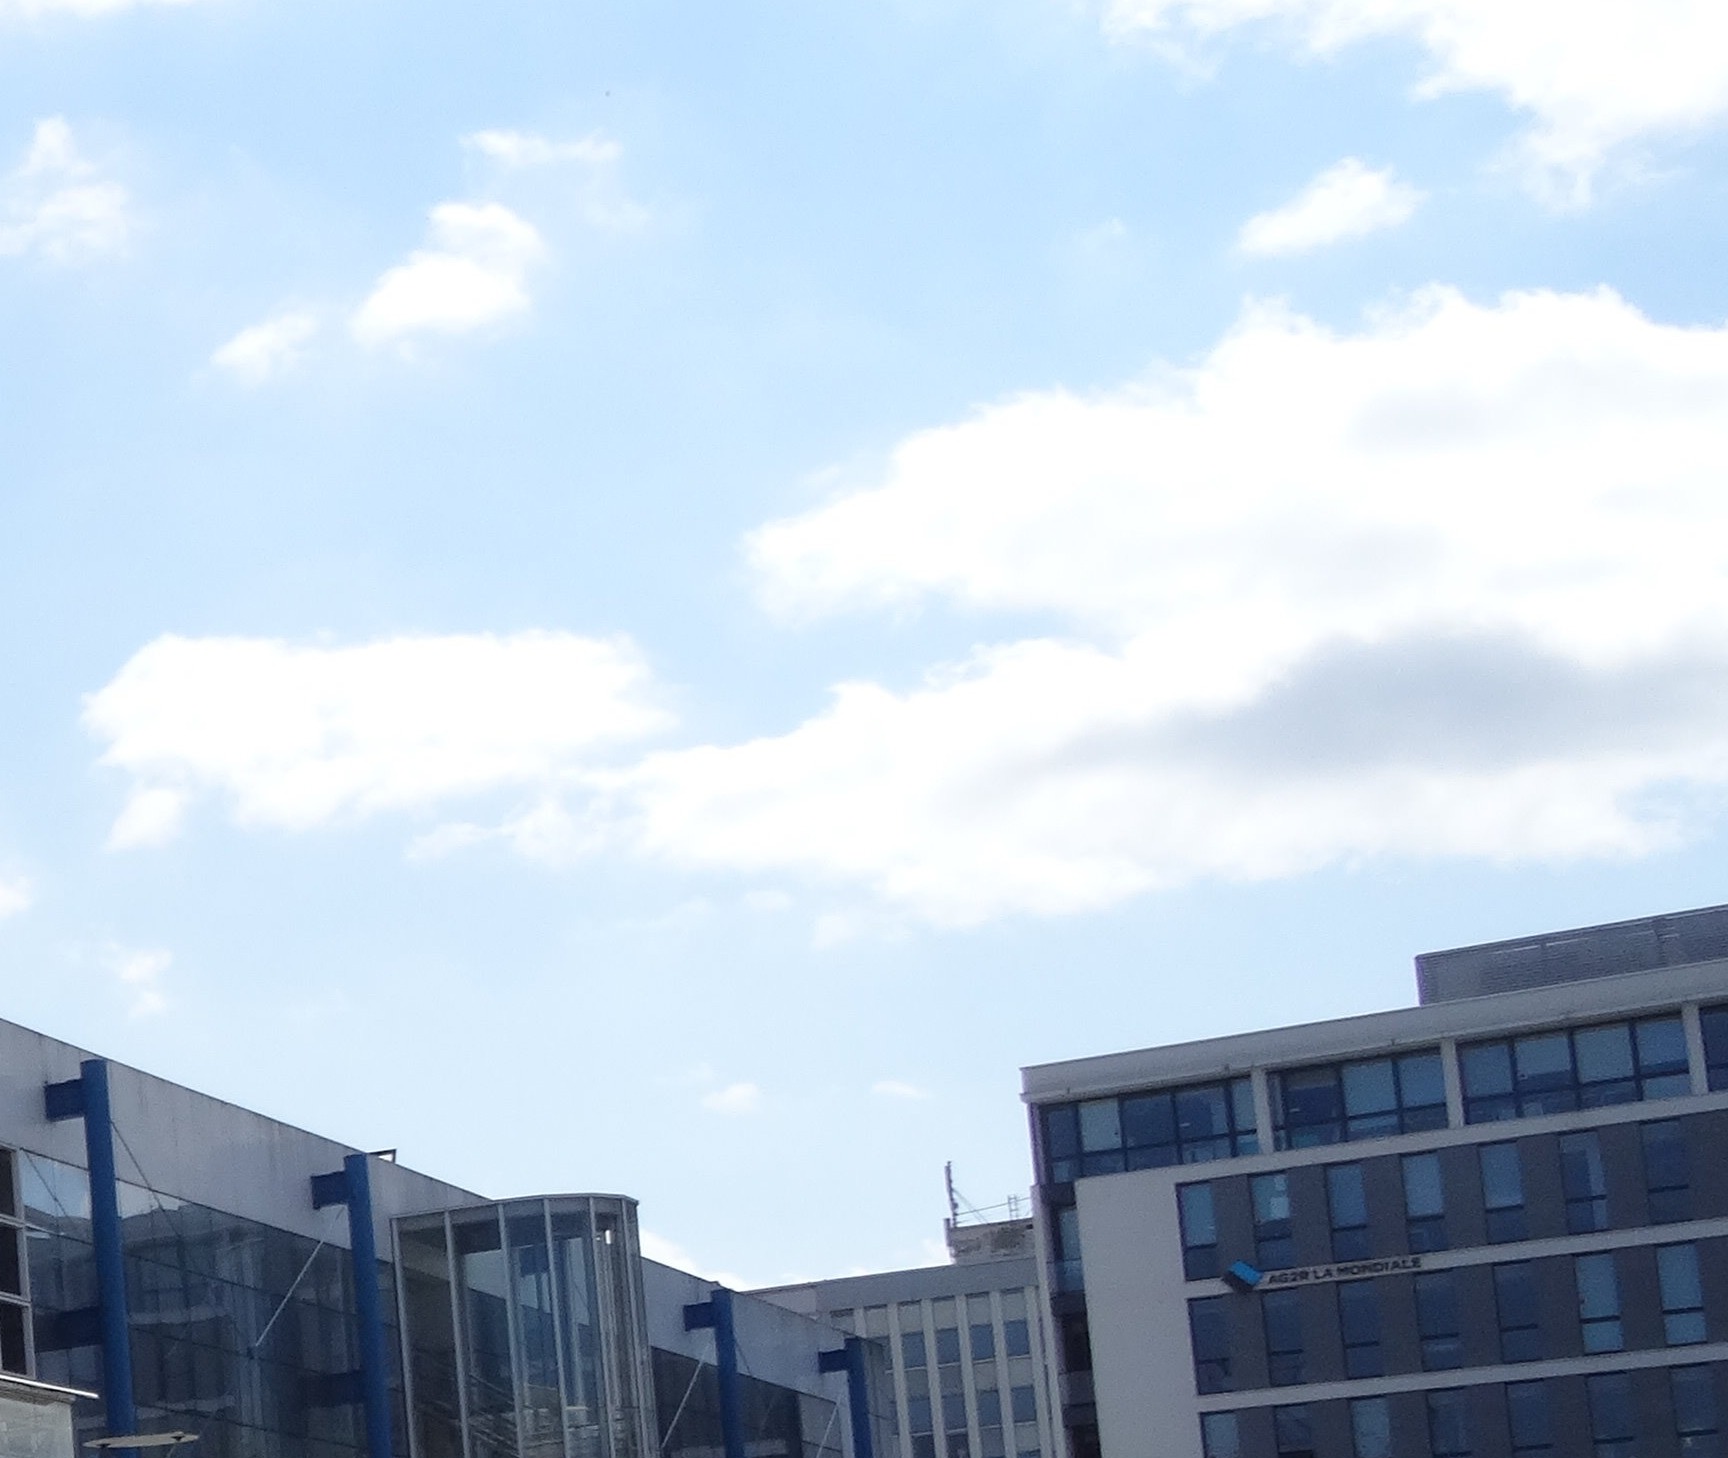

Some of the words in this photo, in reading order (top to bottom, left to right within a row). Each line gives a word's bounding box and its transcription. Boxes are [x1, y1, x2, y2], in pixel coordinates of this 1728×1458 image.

[1268, 1270, 1309, 1284] AG2R
[1313, 1268, 1334, 1280] LA
[1337, 1257, 1422, 1276] MONDIALE
